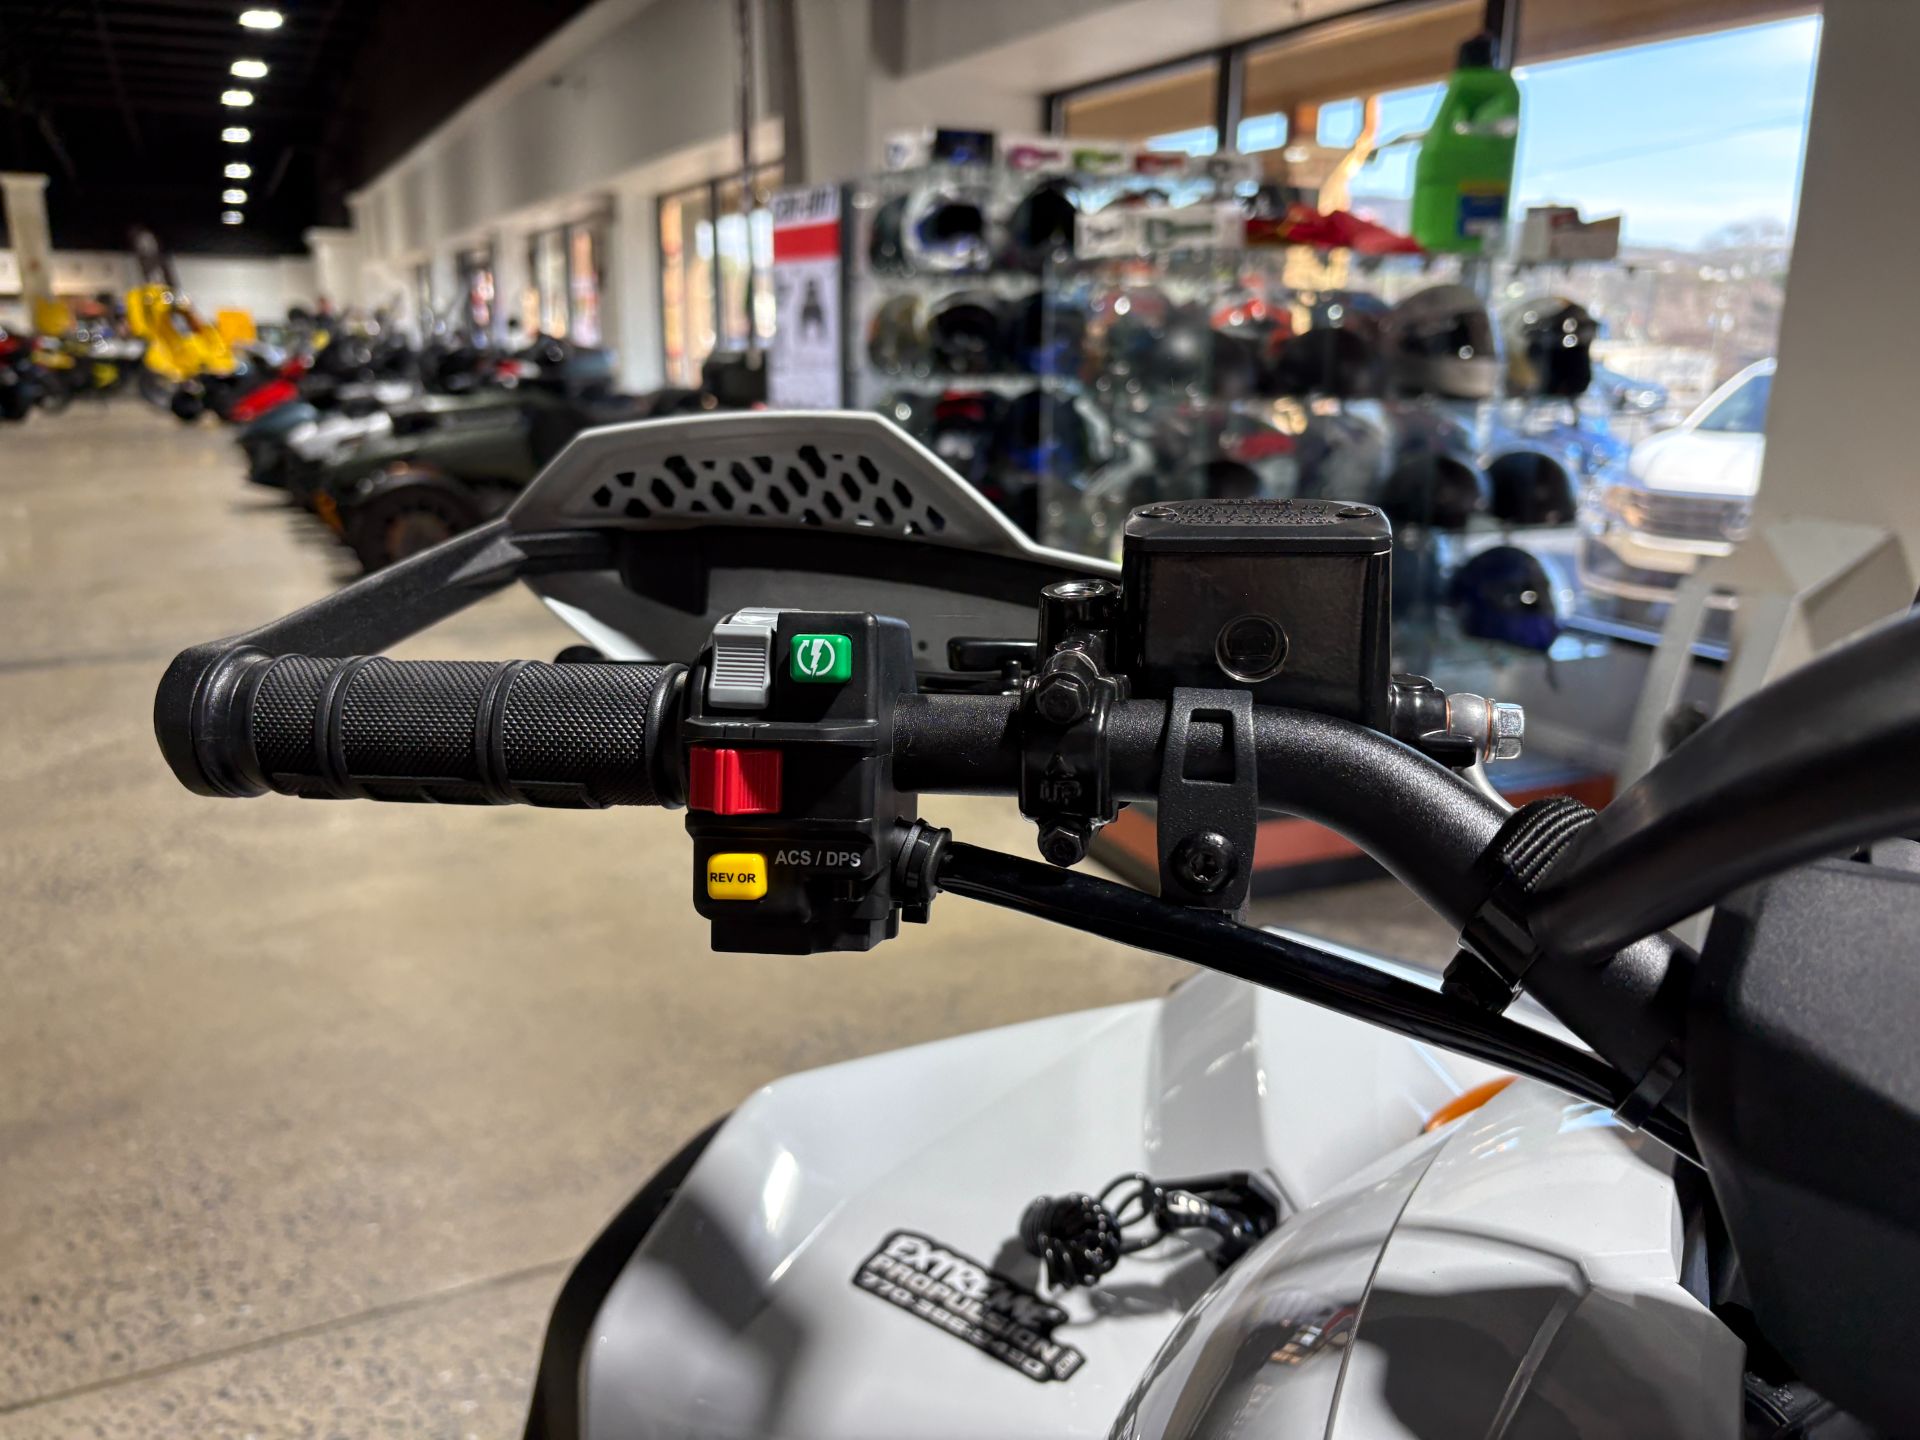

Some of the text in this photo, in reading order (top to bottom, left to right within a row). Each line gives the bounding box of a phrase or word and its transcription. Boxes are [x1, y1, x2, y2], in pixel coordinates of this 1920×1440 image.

[774, 850, 861, 867] ACS / DPS
[709, 872, 756, 884] REV OR
[867, 1253, 1061, 1362] PROPULSION
